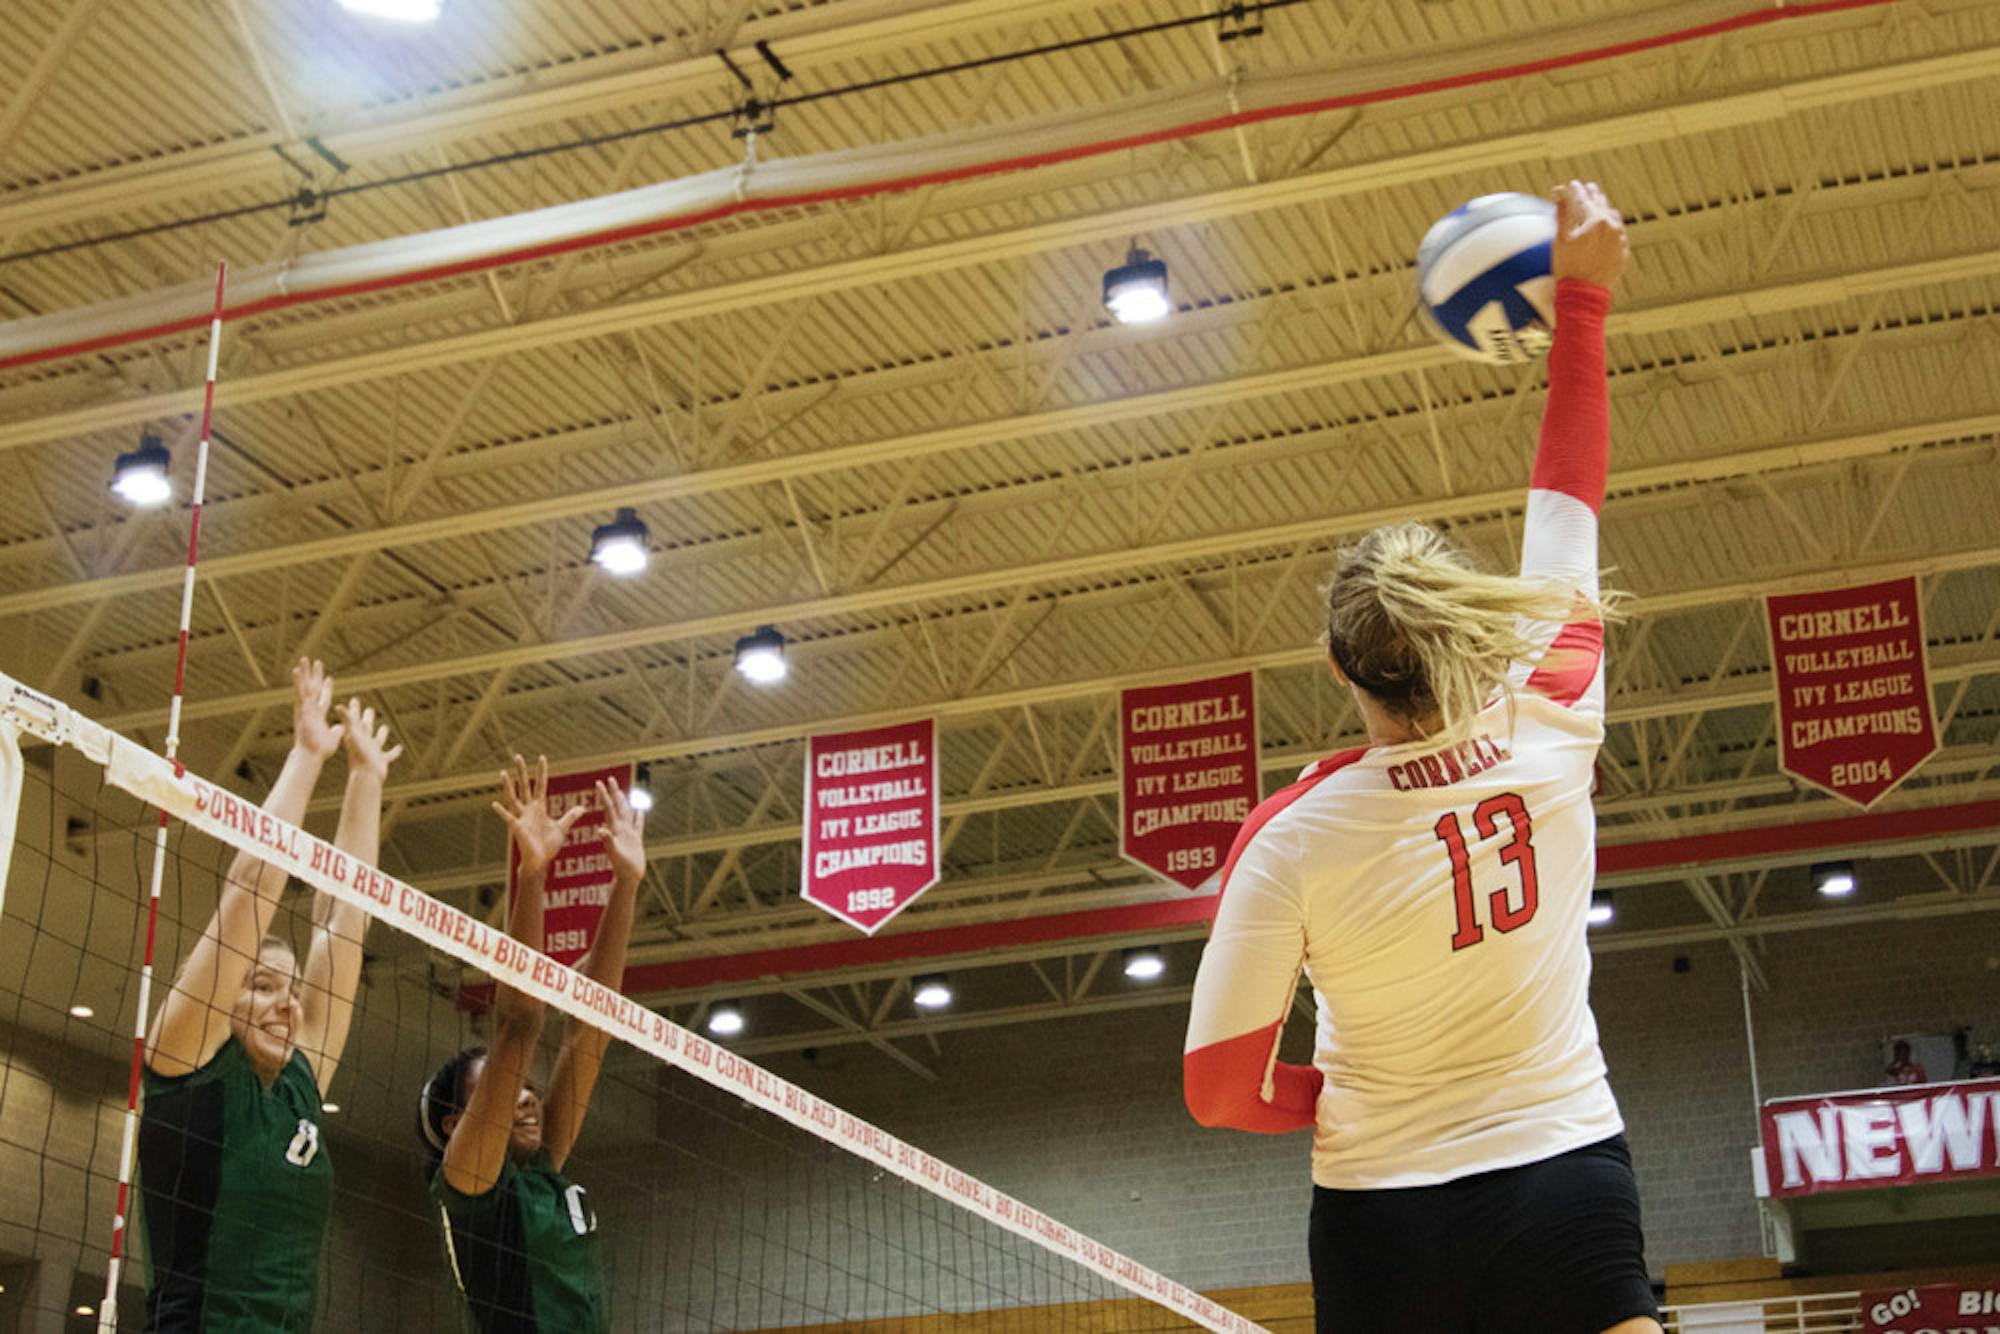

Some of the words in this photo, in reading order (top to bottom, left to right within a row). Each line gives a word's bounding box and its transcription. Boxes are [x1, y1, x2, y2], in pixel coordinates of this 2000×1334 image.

[1779, 600, 1910, 641] CORNELL
[1785, 639, 1914, 675] VOLLEYBALL
[1794, 685, 1826, 708] IVY
[1834, 674, 1913, 704] LEAGUE
[1131, 695, 1246, 733] CORNELL
[1791, 706, 1922, 749] CHAMPIONS
[817, 740, 925, 778] CORNELL
[1130, 732, 1247, 765] VOLLEYBALL
[1136, 775, 1167, 796] IVY
[1173, 765, 1243, 793] LEAGUE
[1830, 757, 1893, 787] 2004
[817, 777, 927, 808] VOLLEYBALL
[820, 818, 850, 840] IVY
[854, 808, 923, 836] LEAGUE
[1133, 797, 1250, 837] CHAMPIONS
[815, 839, 927, 879] CHAMPIONS
[1166, 847, 1216, 872] 1993
[1434, 792, 1538, 952] 13
[543, 882, 610, 909] AMPION
[847, 886, 895, 913] 1992
[193, 781, 299, 861] CORNELL
[310, 841, 348, 882] BIG
[352, 863, 395, 906] RED
[400, 888, 490, 955] CORNELL
[494, 936, 528, 974] BIG
[531, 956, 568, 993] RED
[572, 978, 648, 1036] CORNELL
[653, 1014, 679, 1050] BIG
[683, 1032, 712, 1067] RED
[715, 1050, 780, 1102] CORNELL
[547, 930, 588, 953] 1991
[1773, 1090, 2000, 1188] NEW
[1871, 1289, 1920, 1325] GO!
